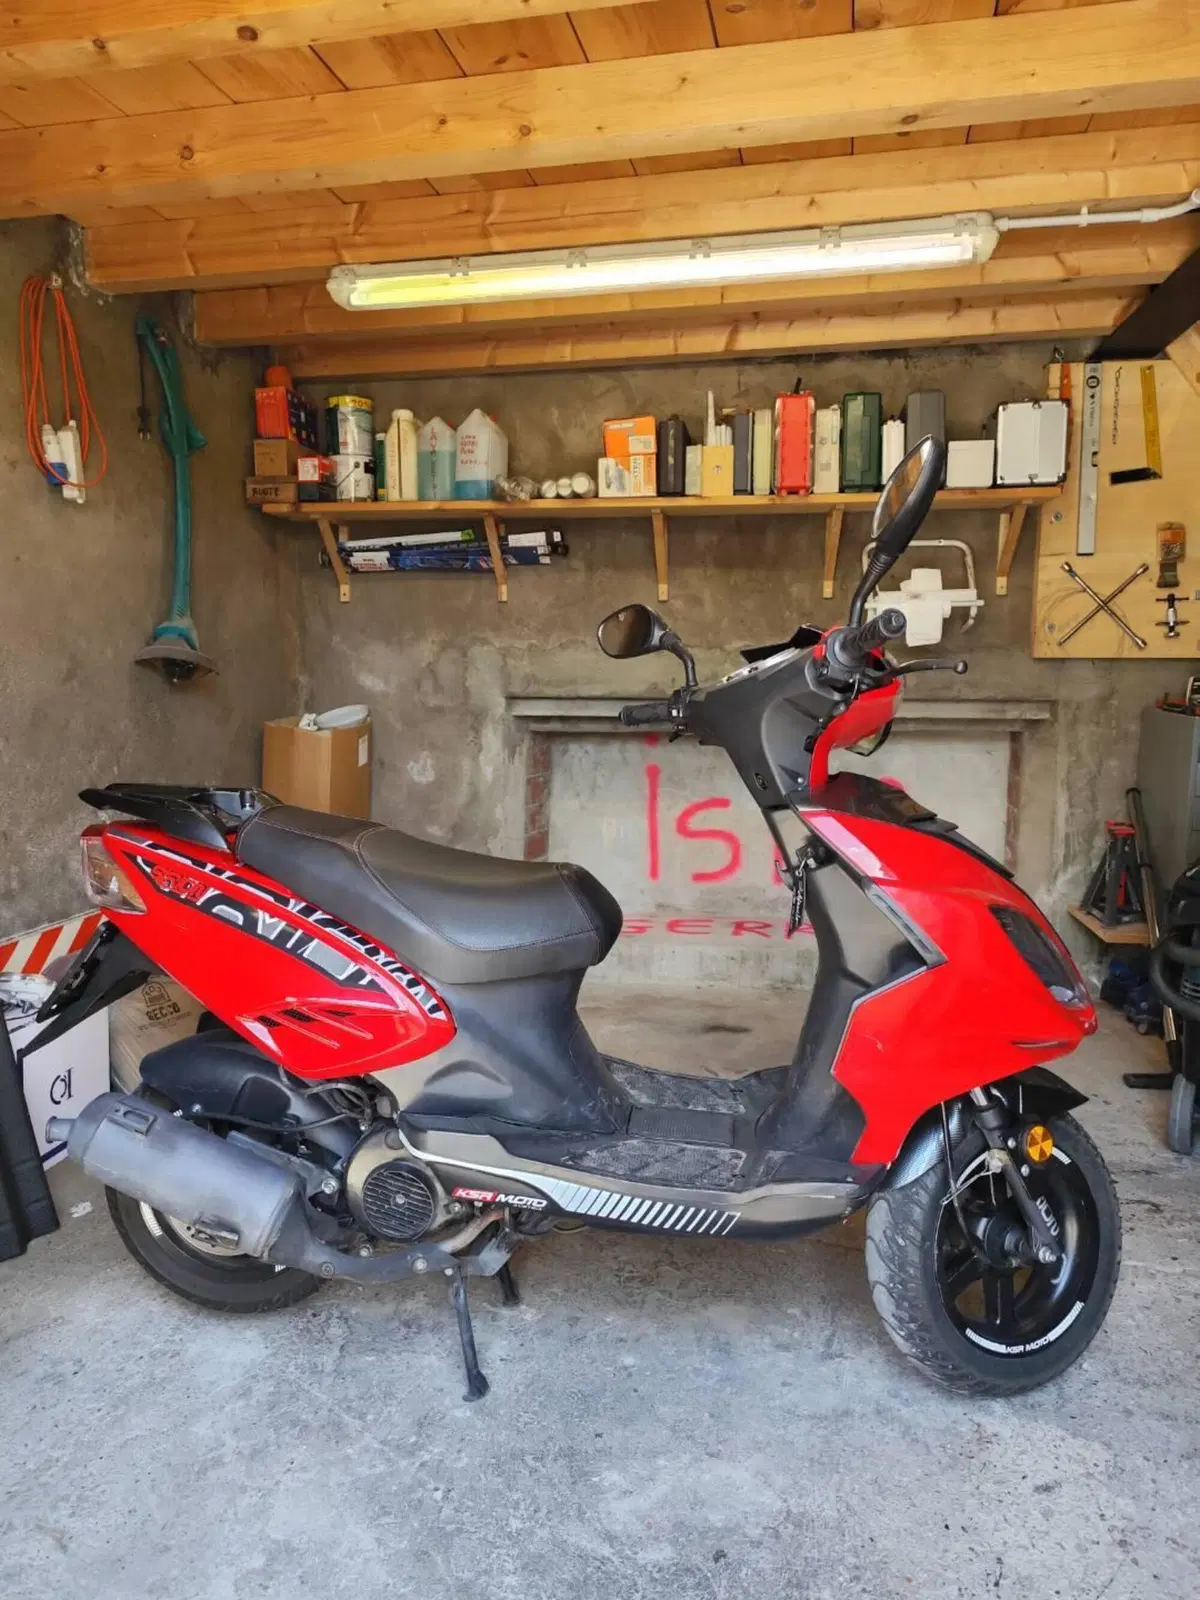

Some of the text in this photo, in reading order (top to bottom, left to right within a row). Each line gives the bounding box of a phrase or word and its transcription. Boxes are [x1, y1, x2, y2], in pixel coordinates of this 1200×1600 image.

[455, 1187, 548, 1208] KSR MOTO
[1006, 1344, 1024, 1354] KSR
